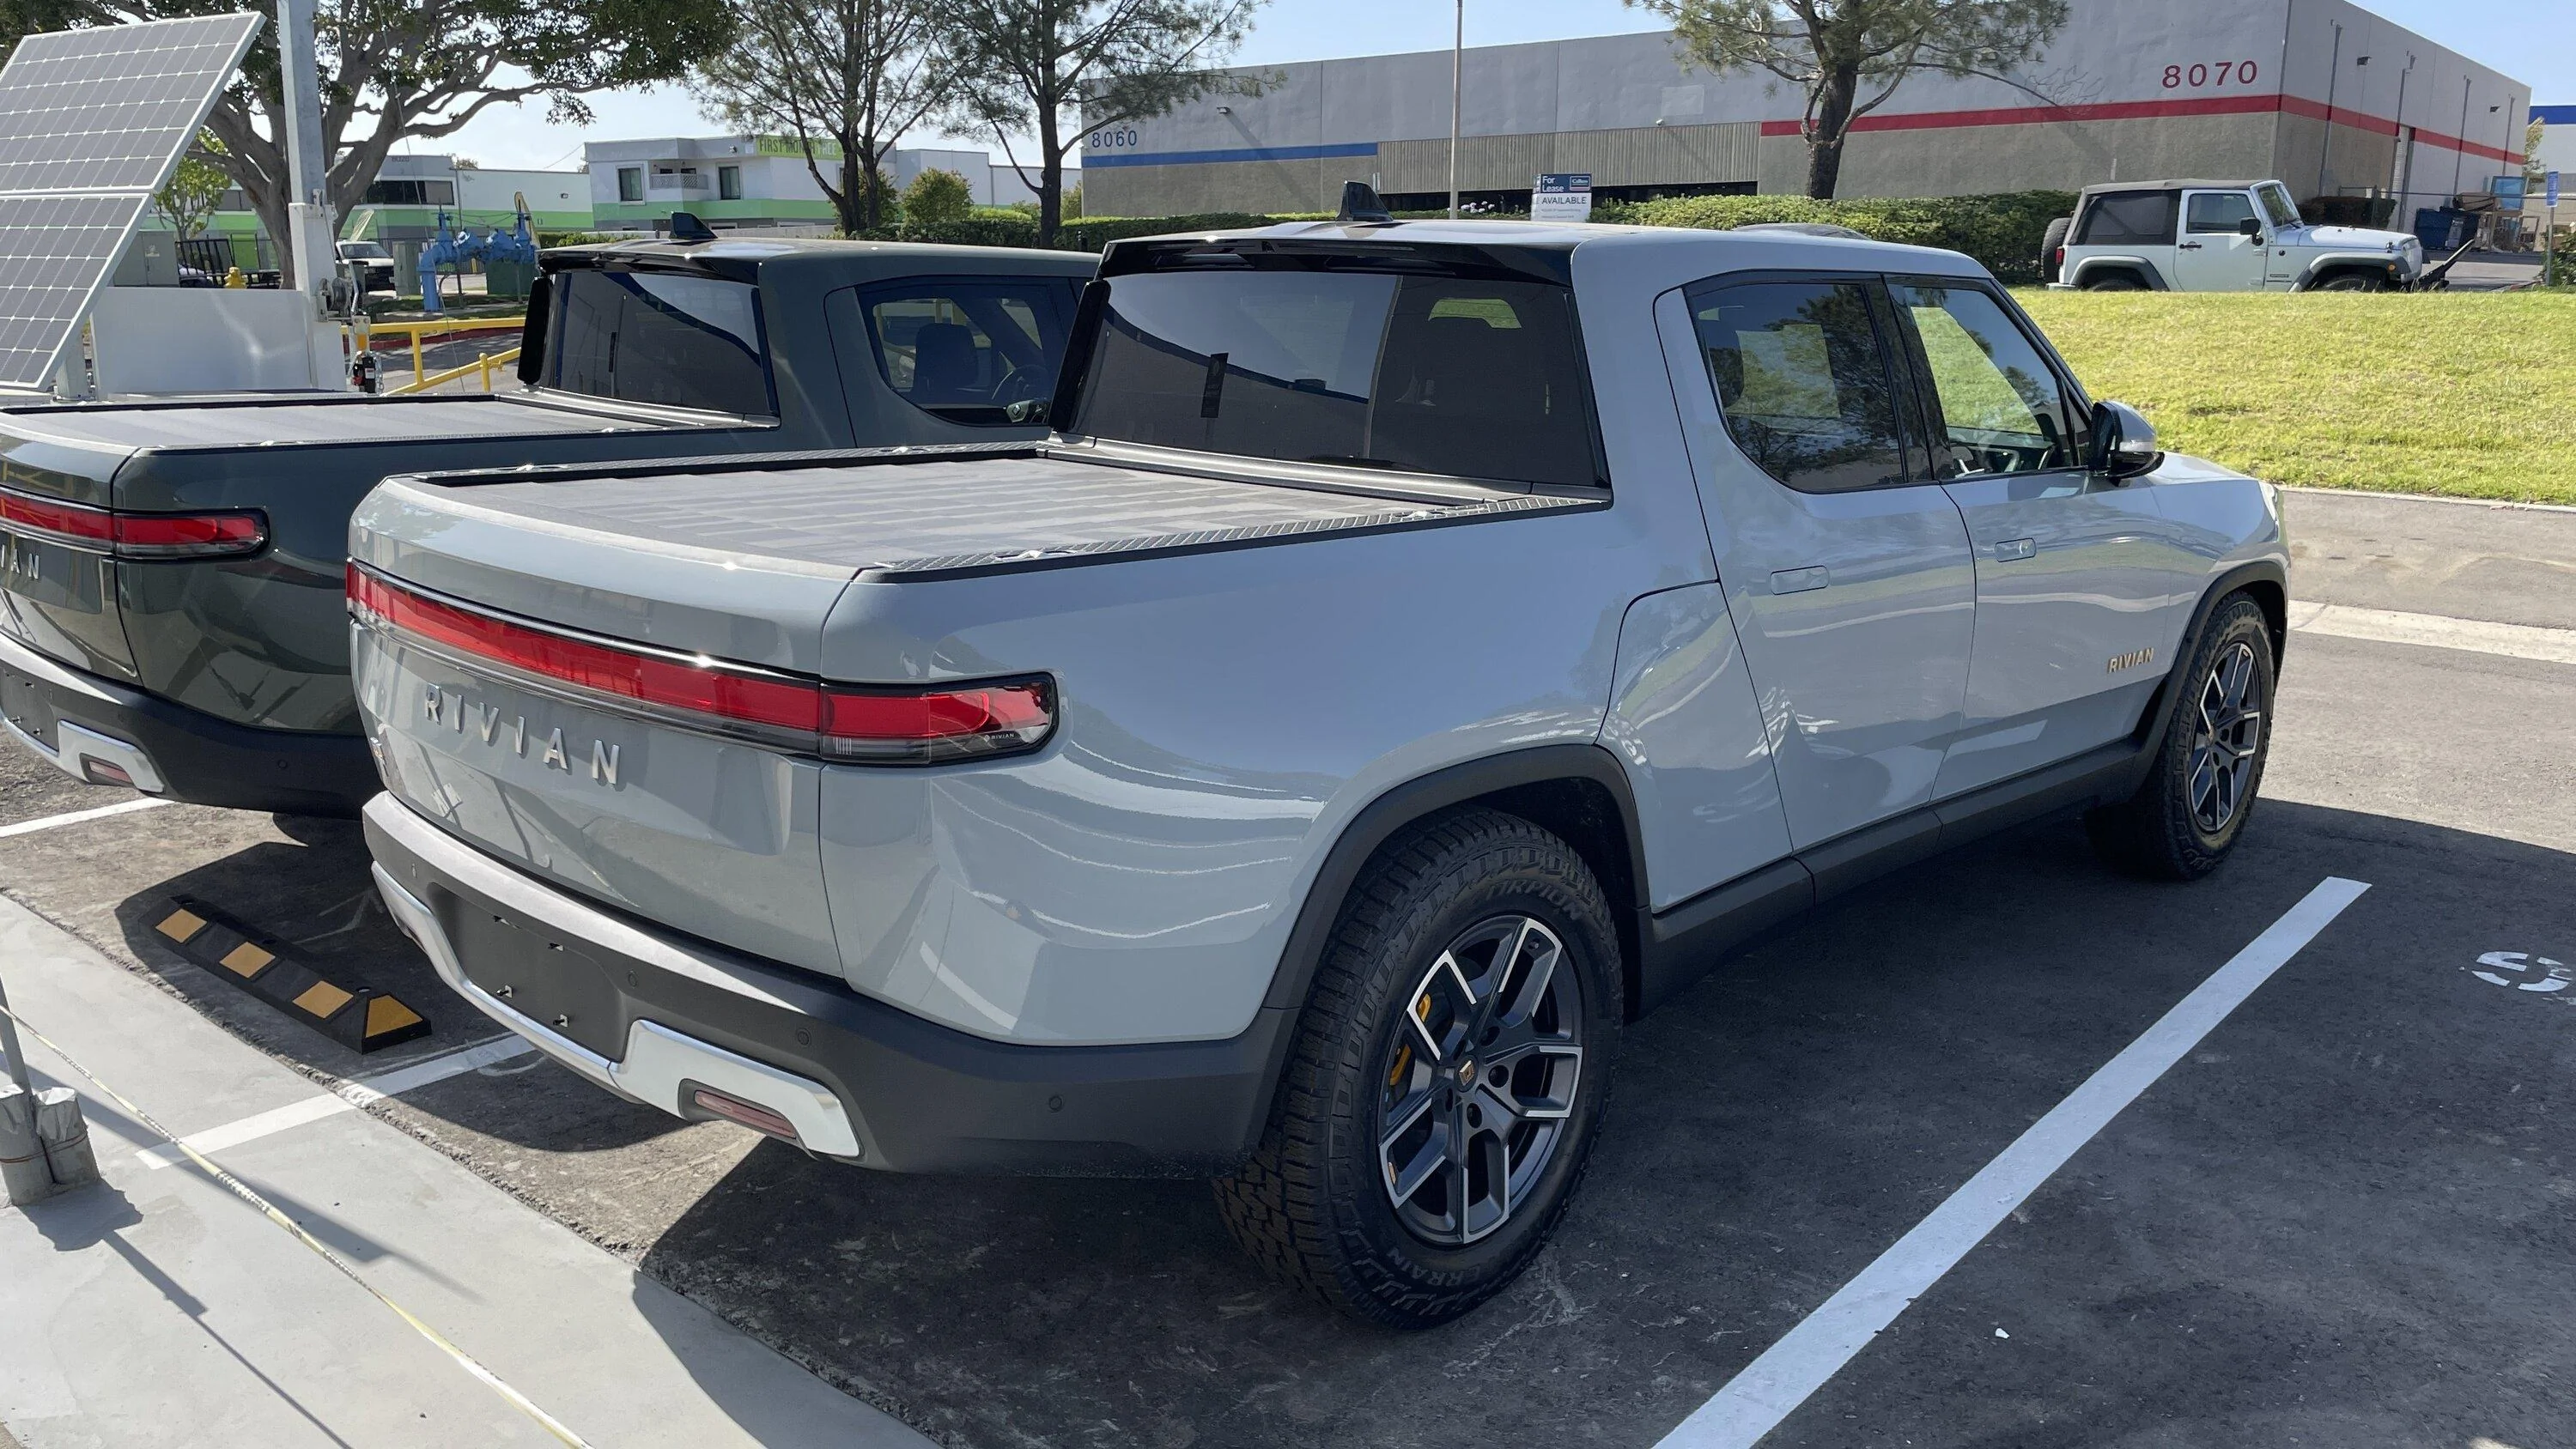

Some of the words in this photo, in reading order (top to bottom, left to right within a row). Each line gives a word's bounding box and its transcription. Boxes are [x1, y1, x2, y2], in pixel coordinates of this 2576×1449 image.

[2162, 60, 2257, 88] 8070
[759, 137, 782, 153] FIRST
[786, 140, 816, 154] MONH
[1091, 130, 1137, 148] 8060
[1542, 175, 1555, 184] For
[2107, 647, 2154, 674] RIVIAN
[425, 682, 620, 785] RIVIAN
